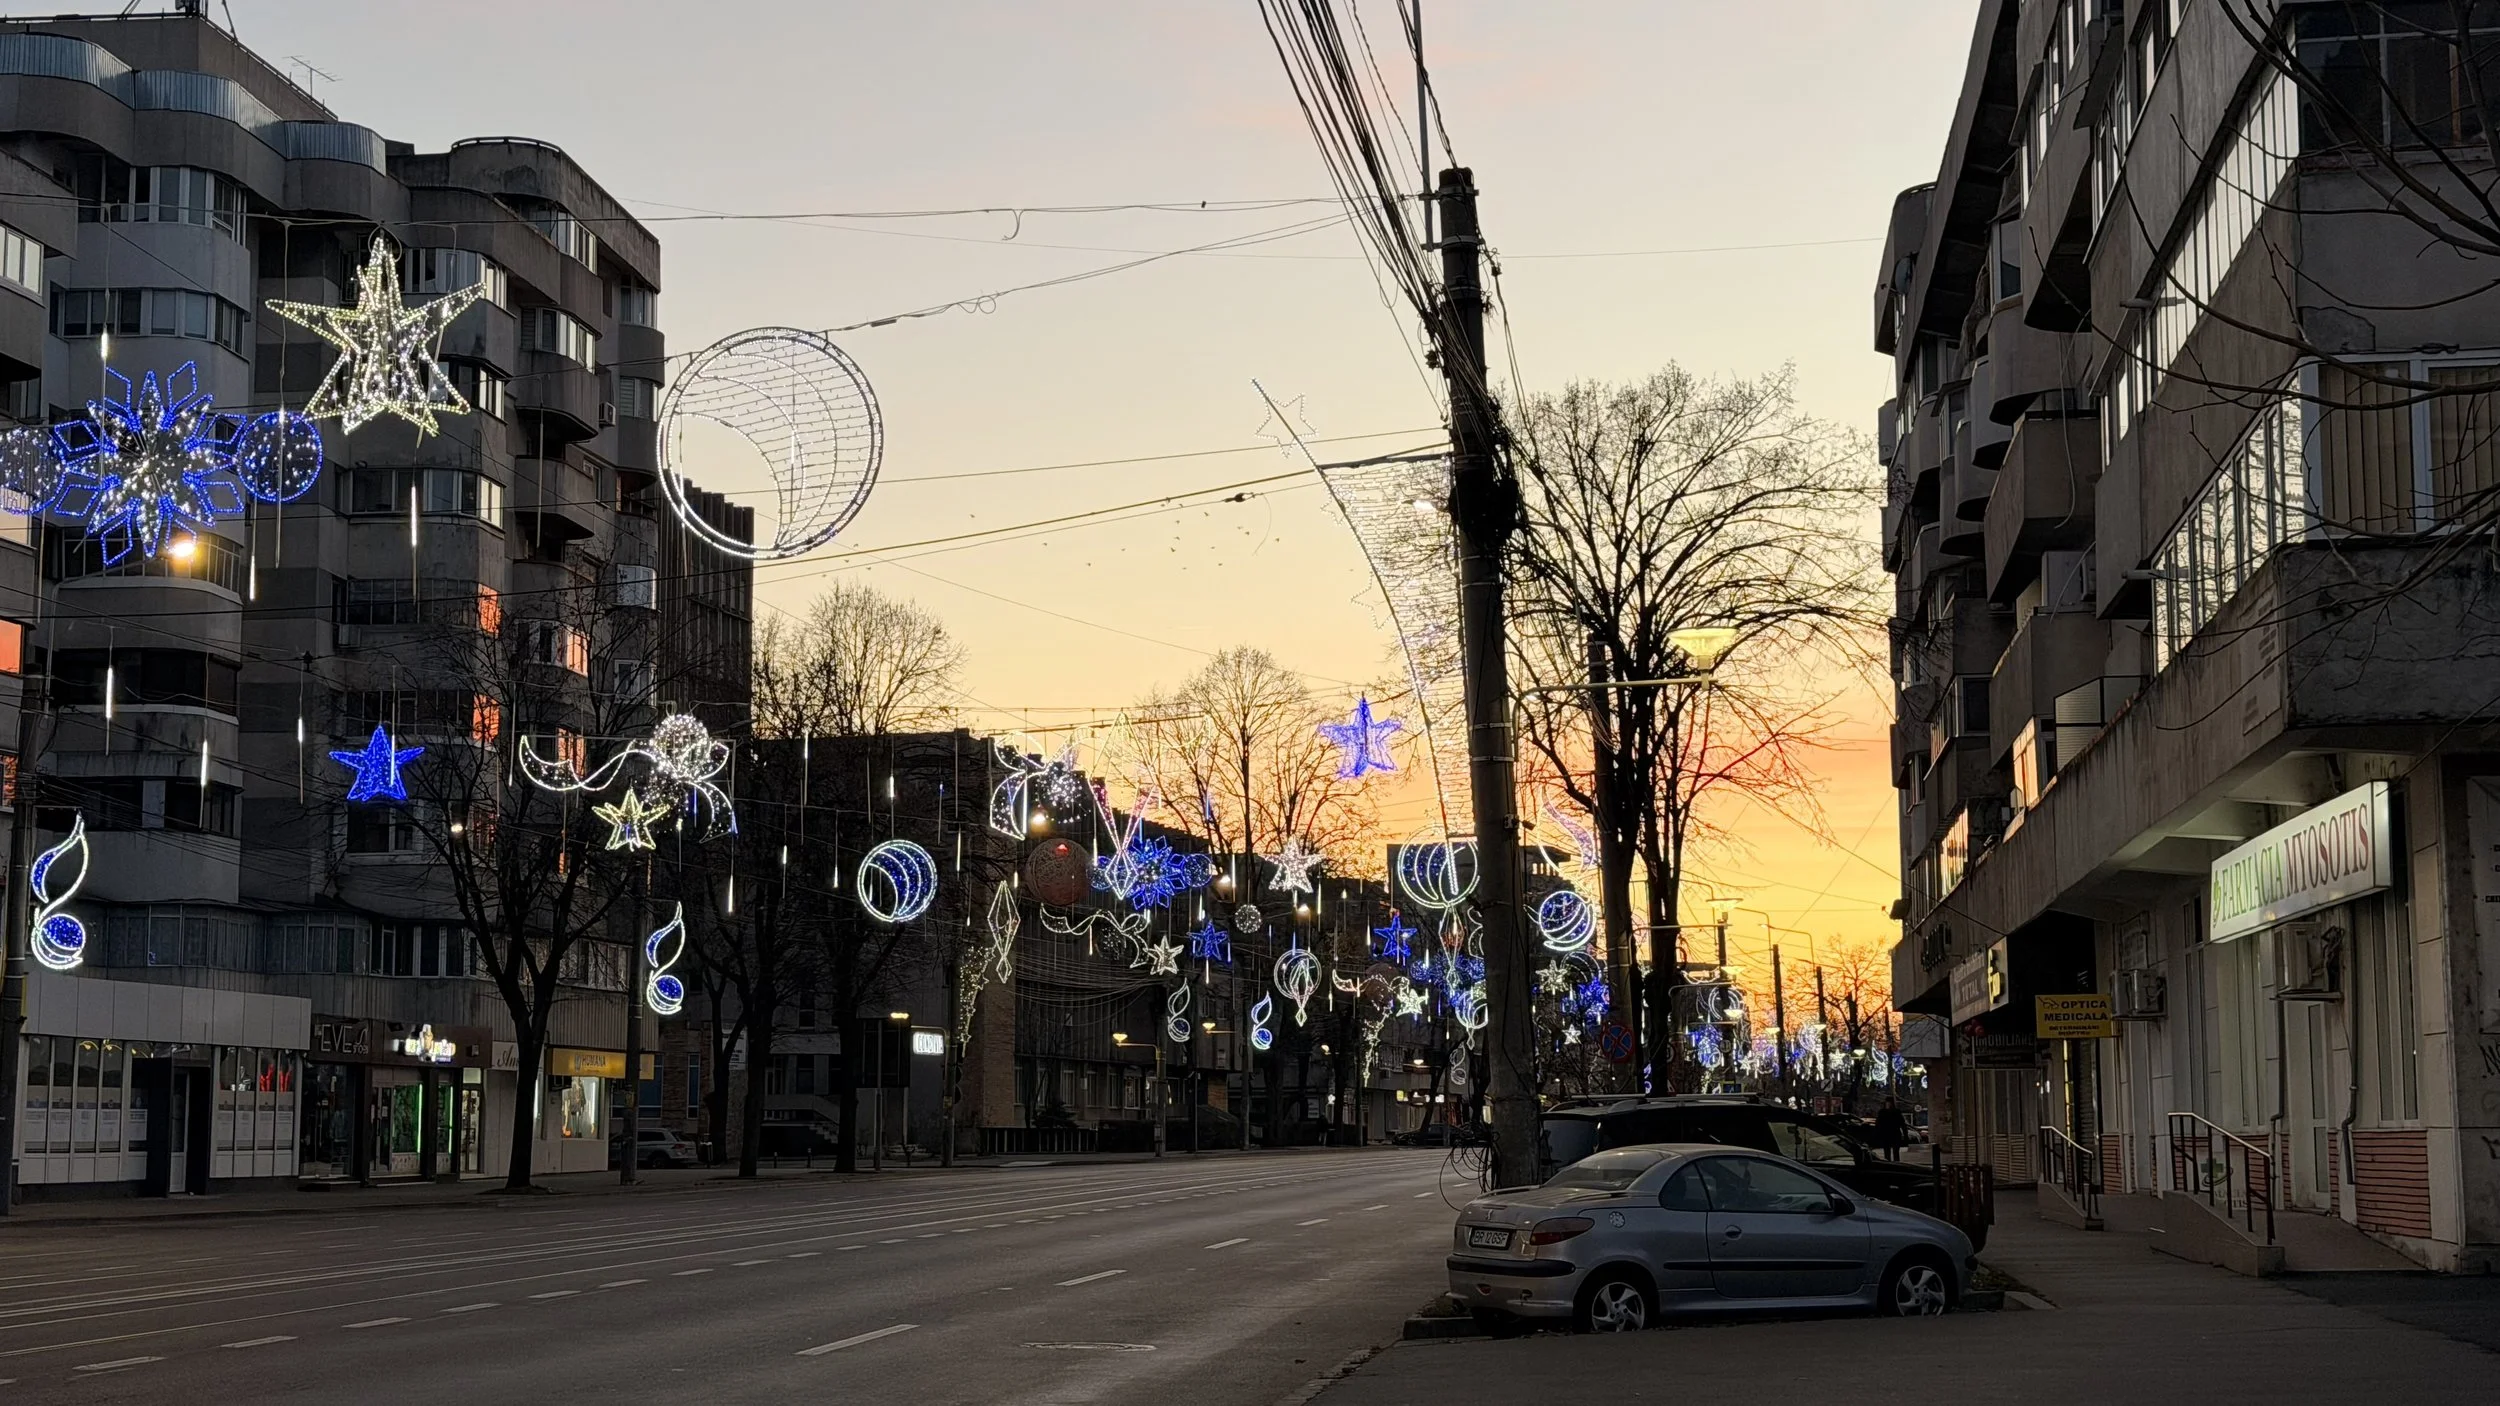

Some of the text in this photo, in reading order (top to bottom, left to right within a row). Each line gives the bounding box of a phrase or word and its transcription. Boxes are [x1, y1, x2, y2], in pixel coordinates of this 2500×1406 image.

[2221, 802, 2369, 922] FARMACIA MYOSOTIS
[2061, 1000, 2107, 1009] OPTICA
[2044, 1012, 2108, 1021] MEDICALA
